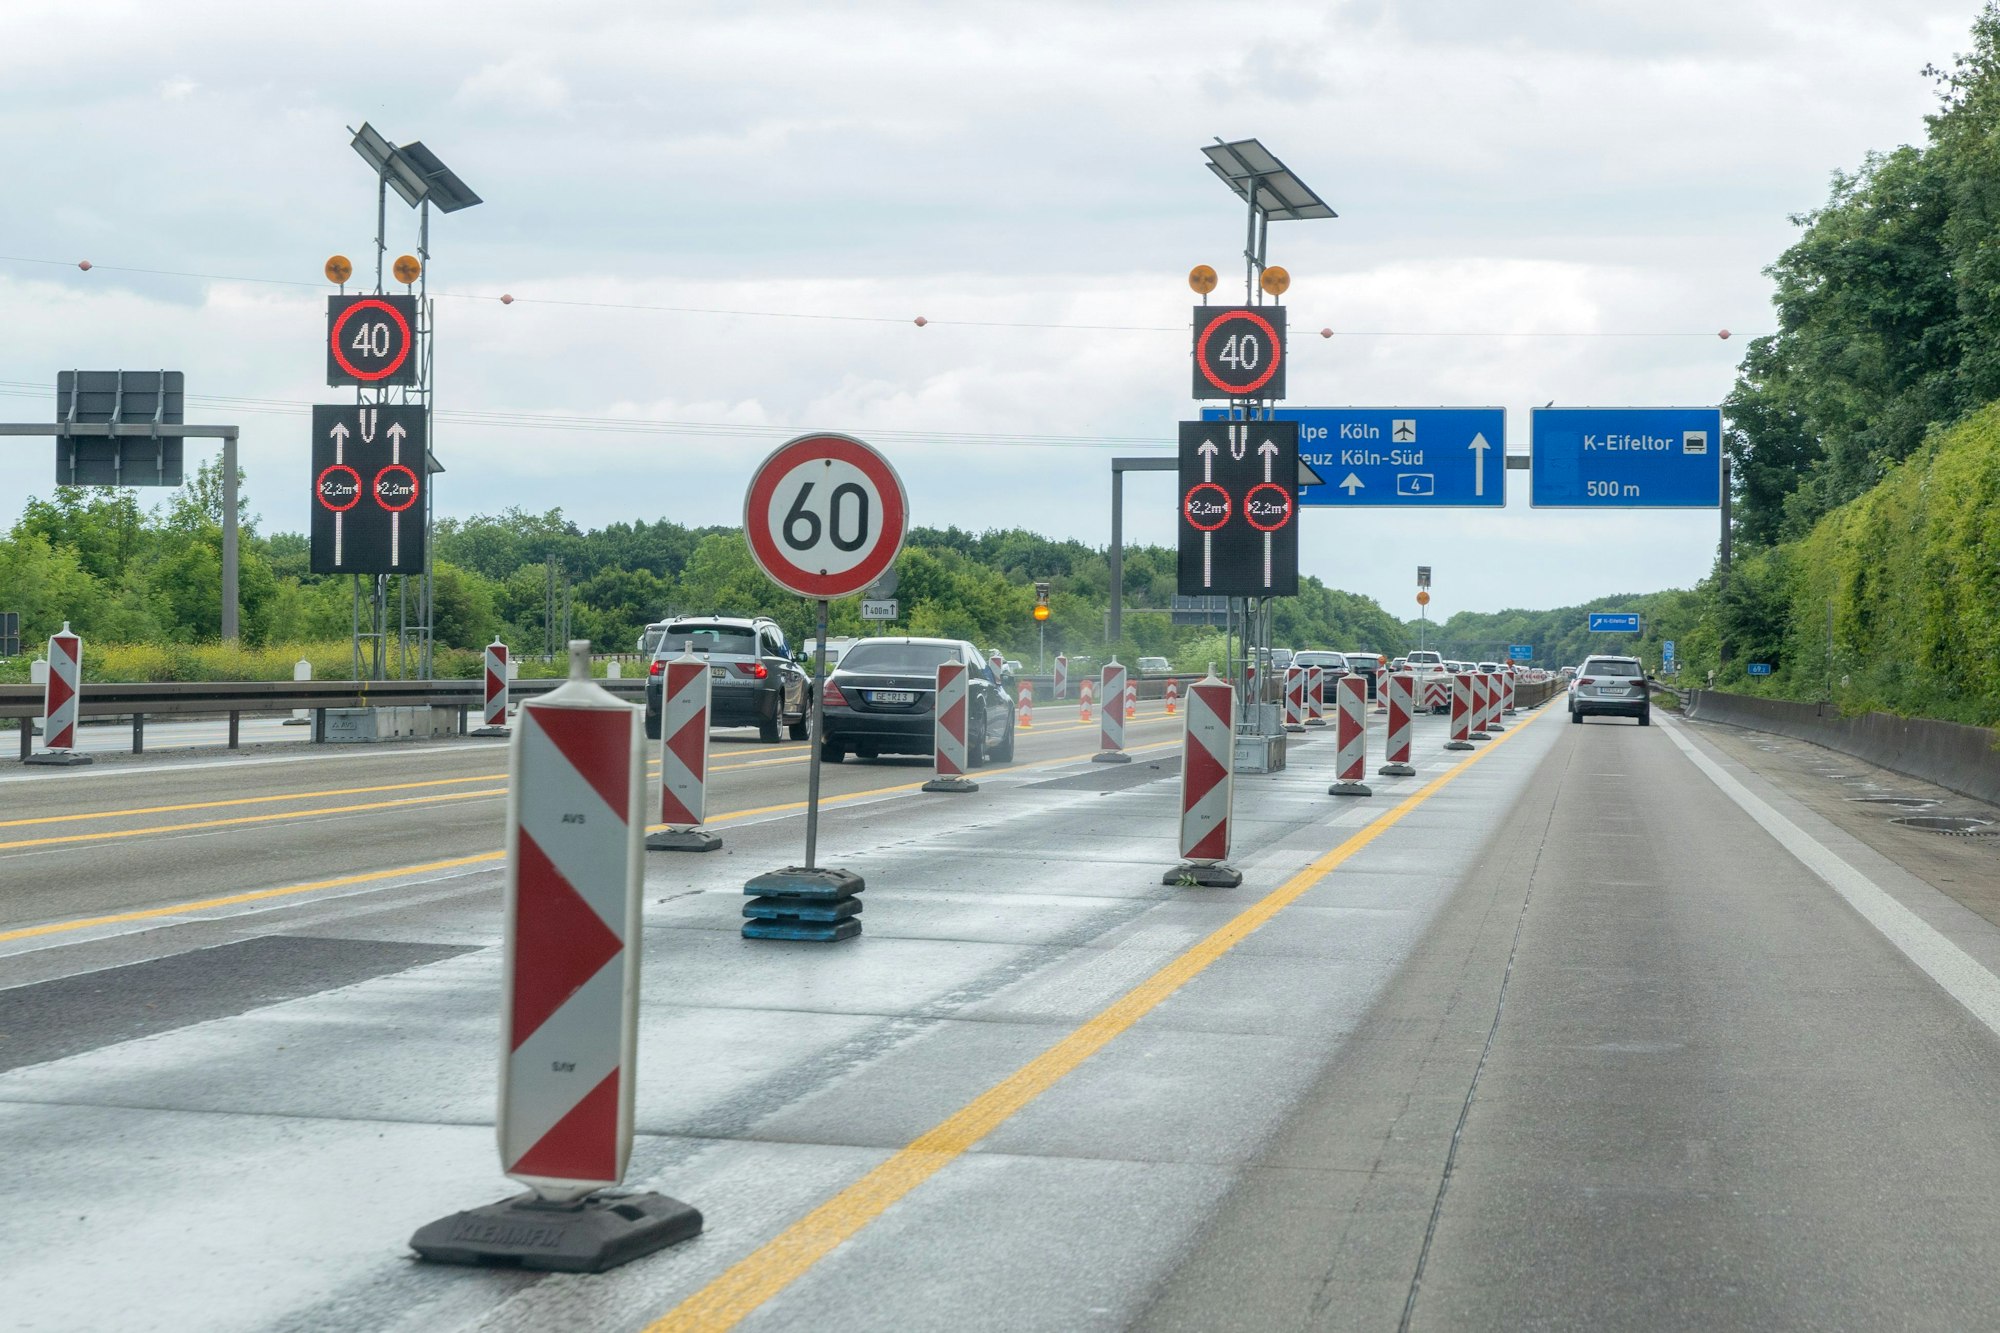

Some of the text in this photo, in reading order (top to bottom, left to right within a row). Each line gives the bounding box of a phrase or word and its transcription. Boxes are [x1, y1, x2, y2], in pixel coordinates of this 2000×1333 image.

[352, 322, 390, 357] 40
[1219, 334, 1259, 370] 40
[1299, 423, 1380, 443] lpe Köln
[1583, 434, 1673, 451] K-Eifeltor
[1299, 449, 1424, 466] euz Köln-Süd
[324, 481, 352, 496] 2,2m
[381, 481, 409, 496] 2,2m
[1410, 478, 1421, 492] 4
[1587, 481, 1640, 497] 500 m
[1192, 501, 1222, 515] 2,2m
[1252, 501, 1282, 515] 2,2m
[783, 482, 869, 552] 60
[561, 813, 586, 825] AVS
